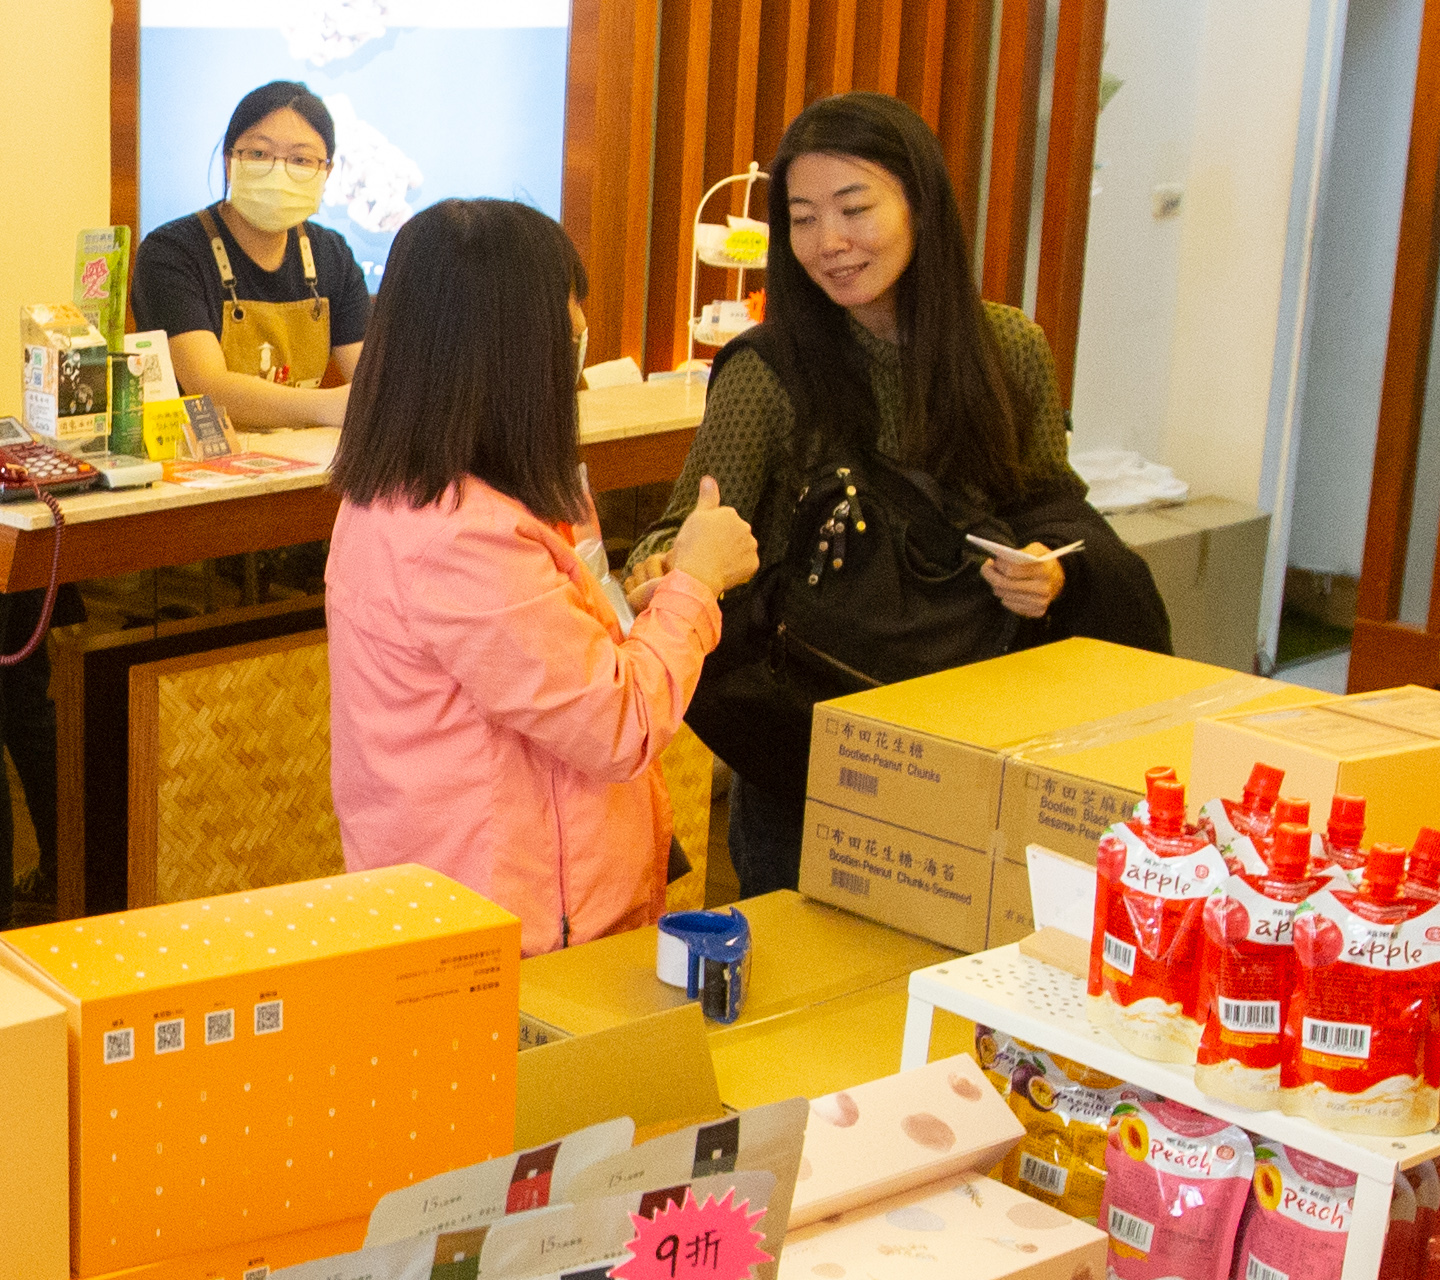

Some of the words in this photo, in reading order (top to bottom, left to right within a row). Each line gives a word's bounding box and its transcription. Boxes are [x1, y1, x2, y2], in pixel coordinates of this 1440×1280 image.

[841, 722, 924, 759] 布田花生糖
[1126, 869, 1192, 895] apple
[1348, 940, 1423, 966] apple
[1150, 1139, 1213, 1175] Peach
[1283, 1186, 1345, 1229] Peach
[655, 1228, 722, 1279] 9折
